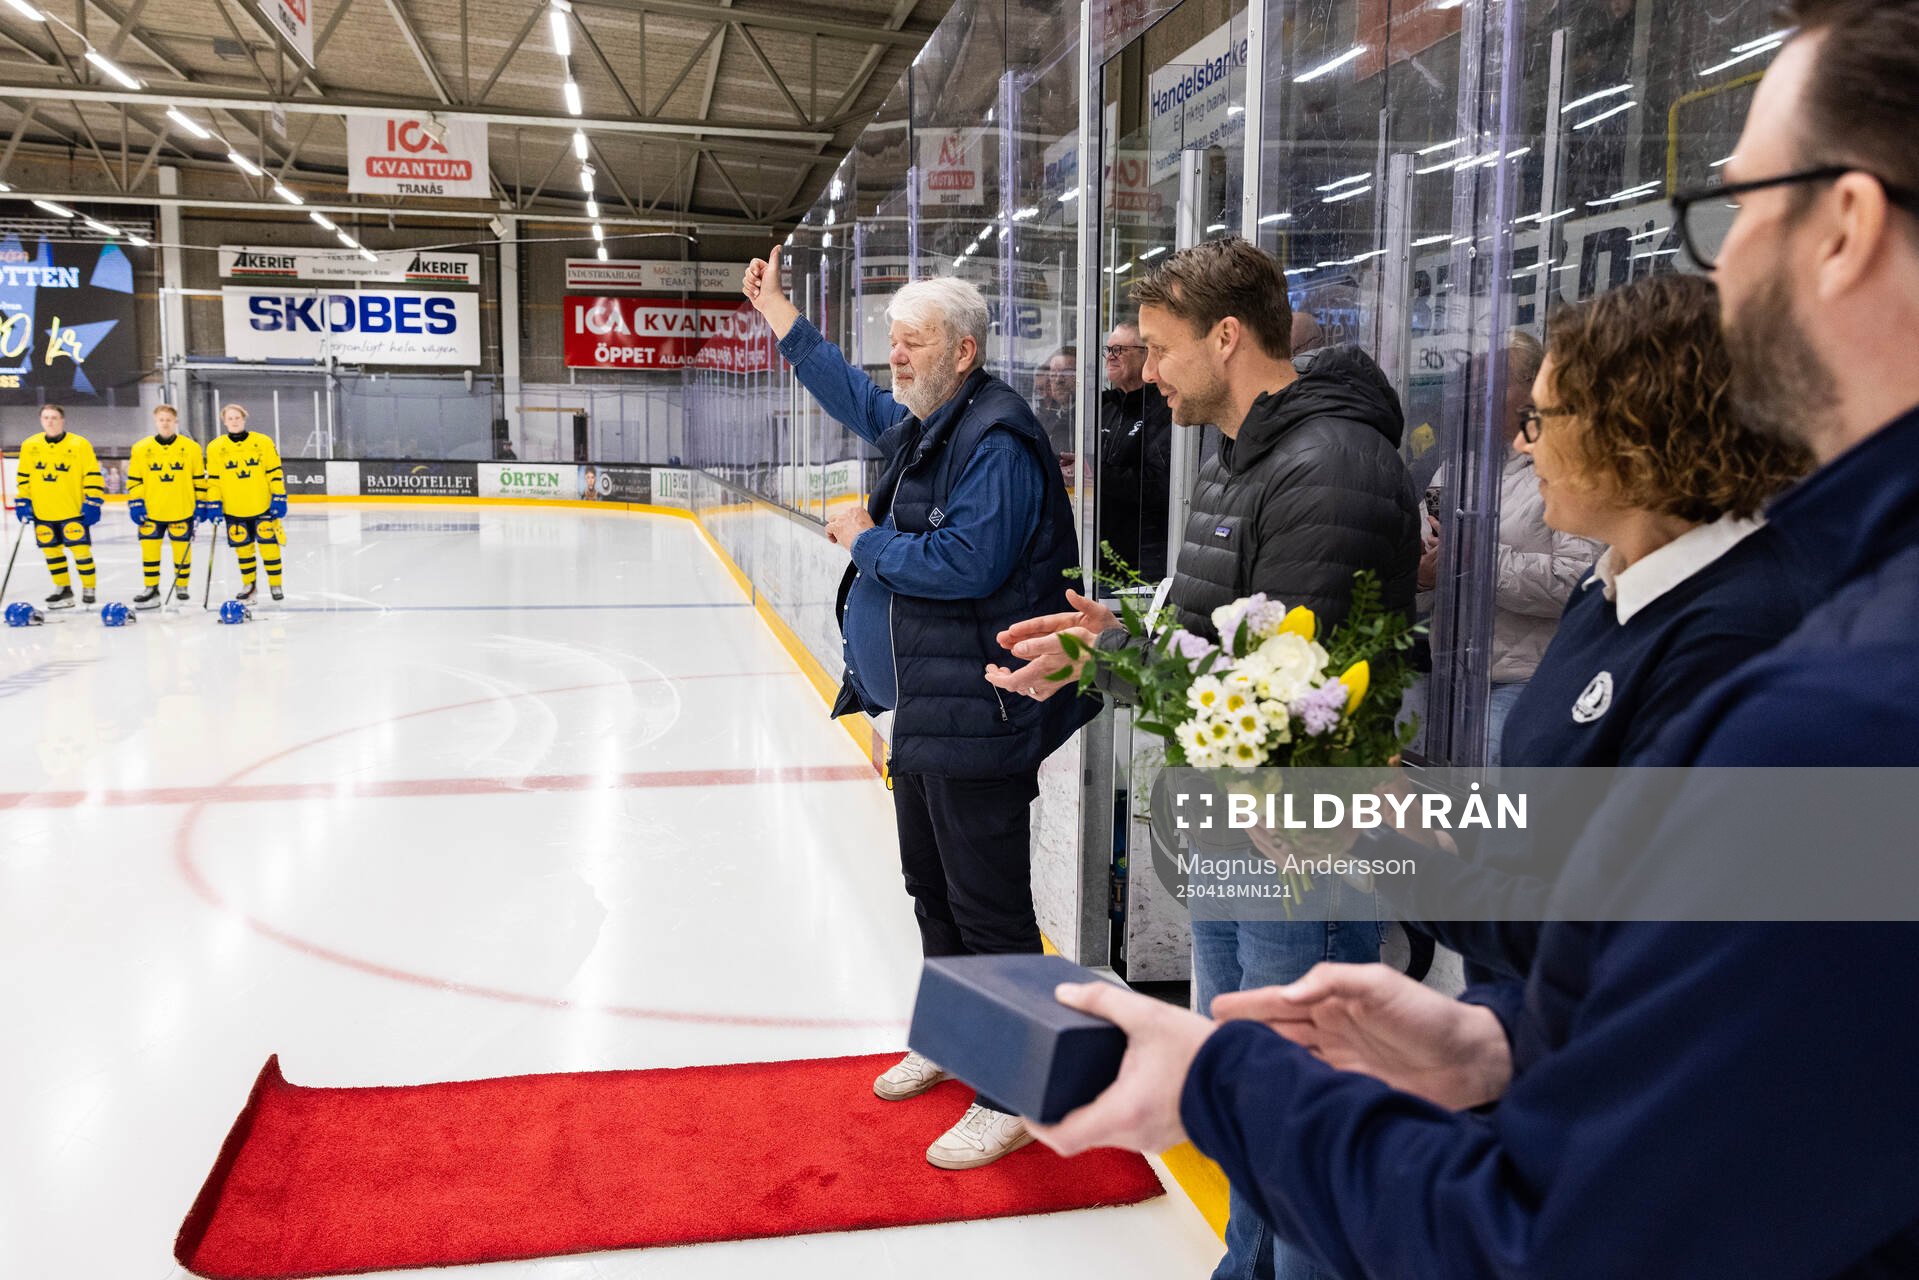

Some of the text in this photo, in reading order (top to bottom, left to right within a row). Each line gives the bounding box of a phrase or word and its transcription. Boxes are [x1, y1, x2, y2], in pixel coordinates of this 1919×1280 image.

[372, 160, 467, 178] KVANTUM
[397, 182, 444, 195] TRANÅS
[407, 252, 468, 275] ÅKERIET
[0, 265, 80, 288] TTEN
[249, 295, 457, 335] SKOBES
[594, 342, 656, 365] ÖPPET
[304, 475, 325, 485] AB
[367, 475, 473, 490] BADHOTELLET
[500, 467, 560, 488] ÖRTEN
